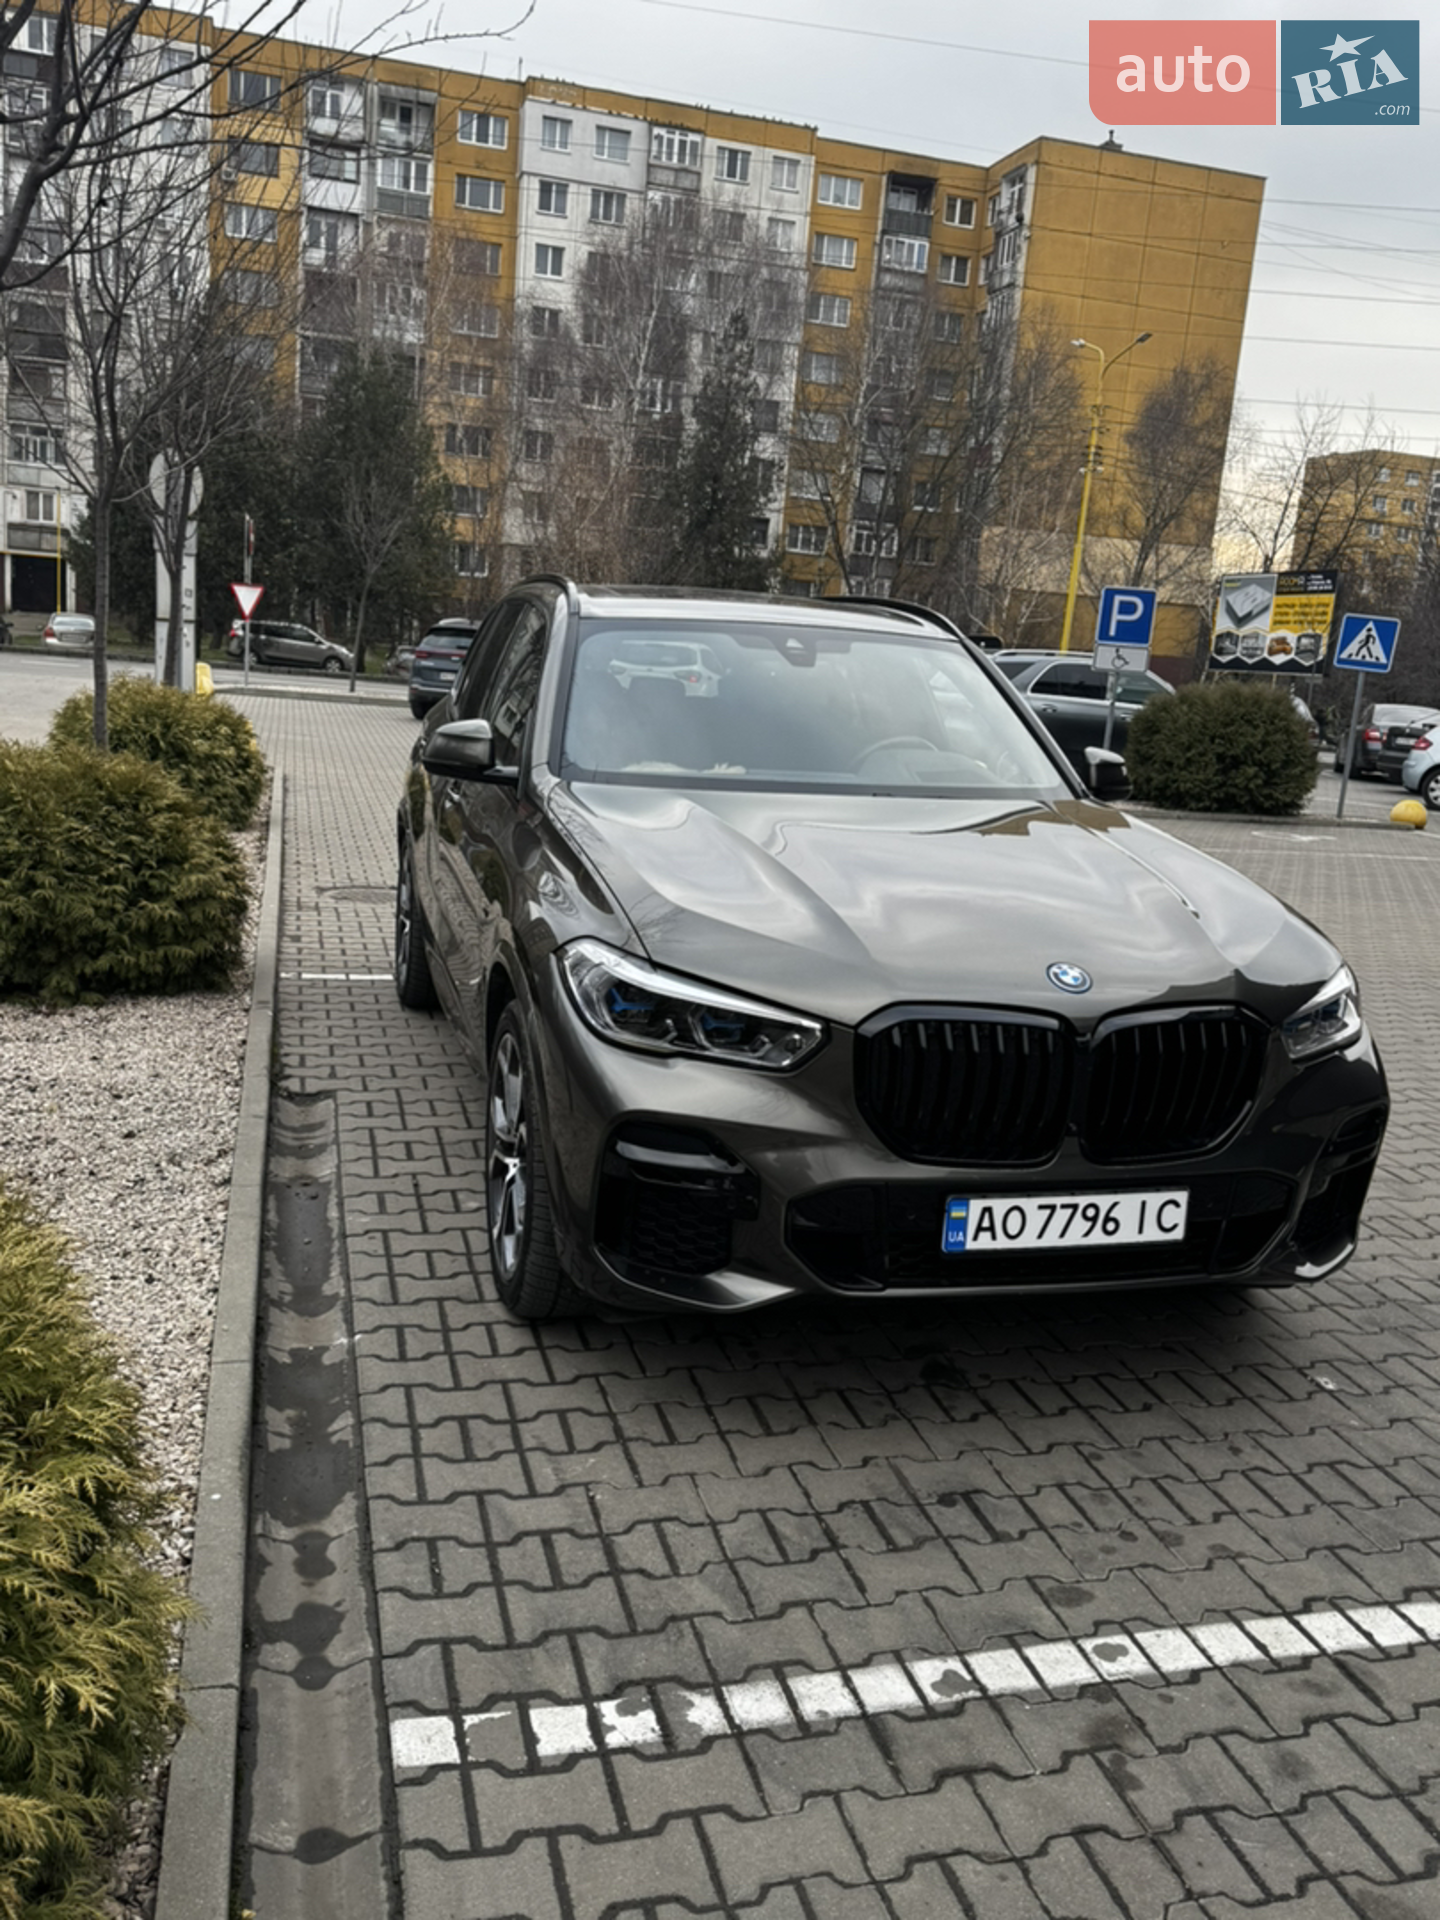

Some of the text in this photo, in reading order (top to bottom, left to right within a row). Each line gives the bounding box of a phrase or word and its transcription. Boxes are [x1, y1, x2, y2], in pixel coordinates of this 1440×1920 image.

[1109, 594, 1144, 637] P
[948, 1231, 965, 1243] UA
[972, 1199, 1182, 1242] AO 7796 IC
